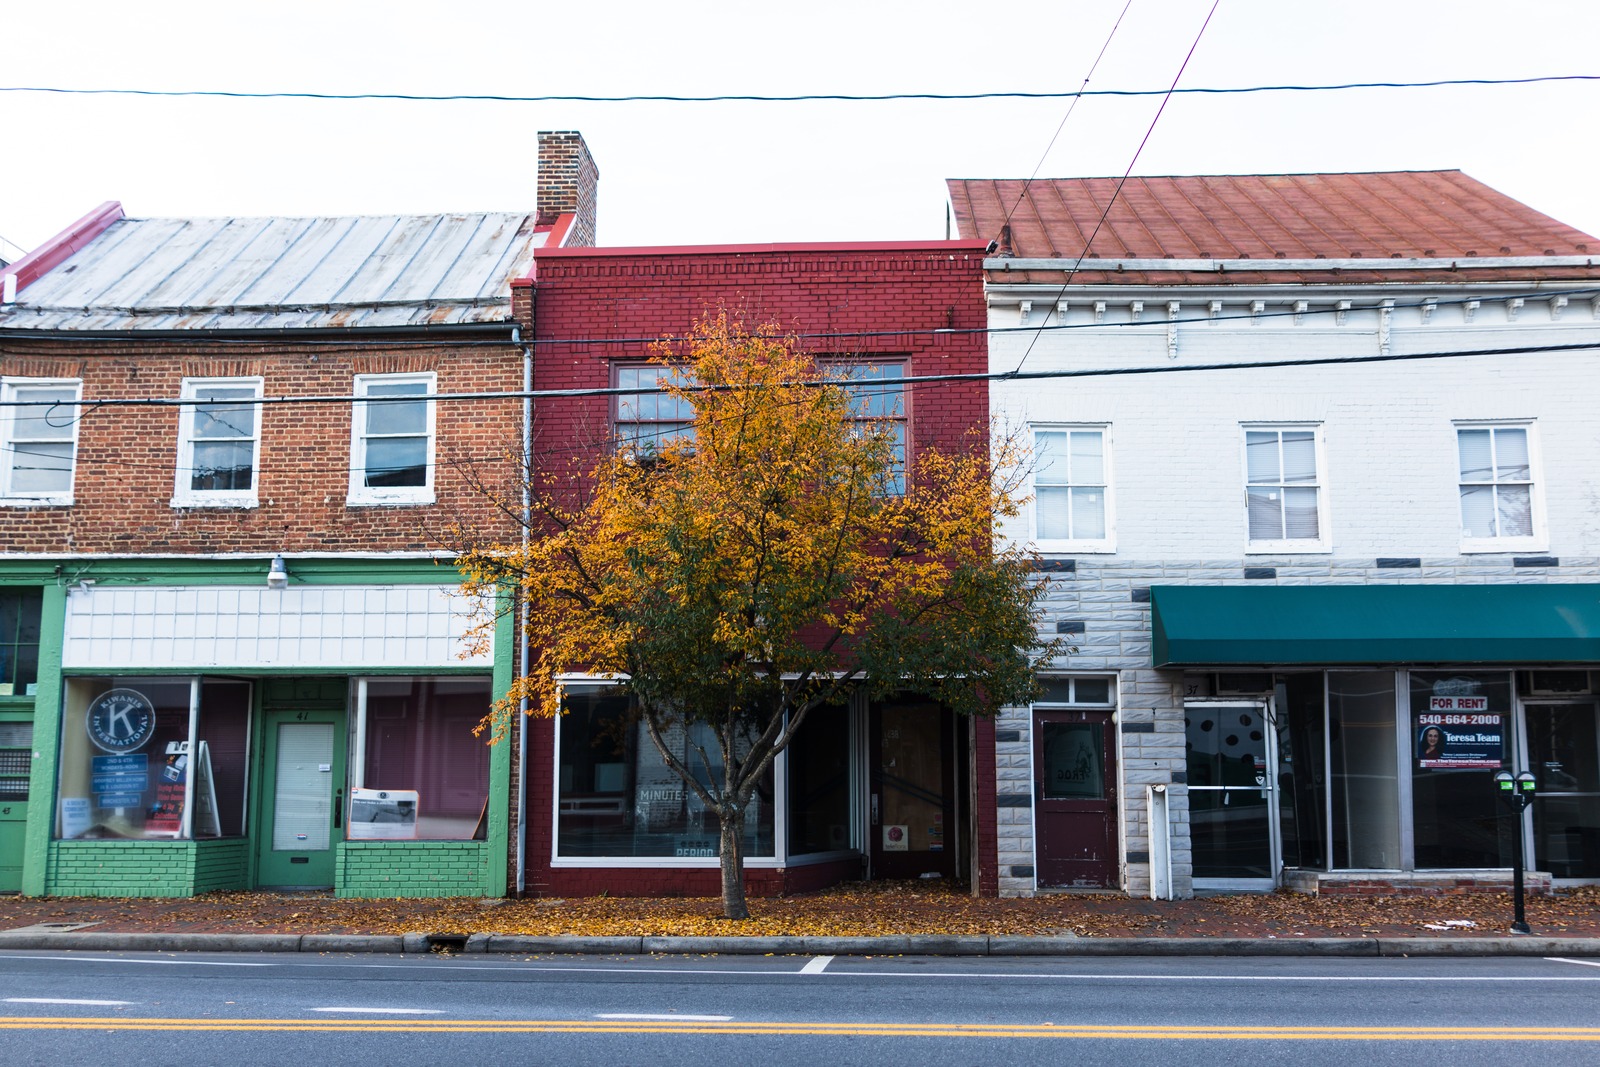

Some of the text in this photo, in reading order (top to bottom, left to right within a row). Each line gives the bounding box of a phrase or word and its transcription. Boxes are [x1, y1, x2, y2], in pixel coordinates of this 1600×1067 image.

[1187, 685, 1198, 695] 37
[101, 696, 143, 709] KIWANIS
[1432, 699, 1485, 708] FOR RENT
[108, 703, 135, 738] K
[296, 712, 309, 720] 41
[1420, 714, 1500, 724] 540-664-2000
[94, 714, 148, 746] INTERNATIONAL
[1446, 733, 1500, 742] Teresa Team
[640, 790, 688, 800] MINUTES
